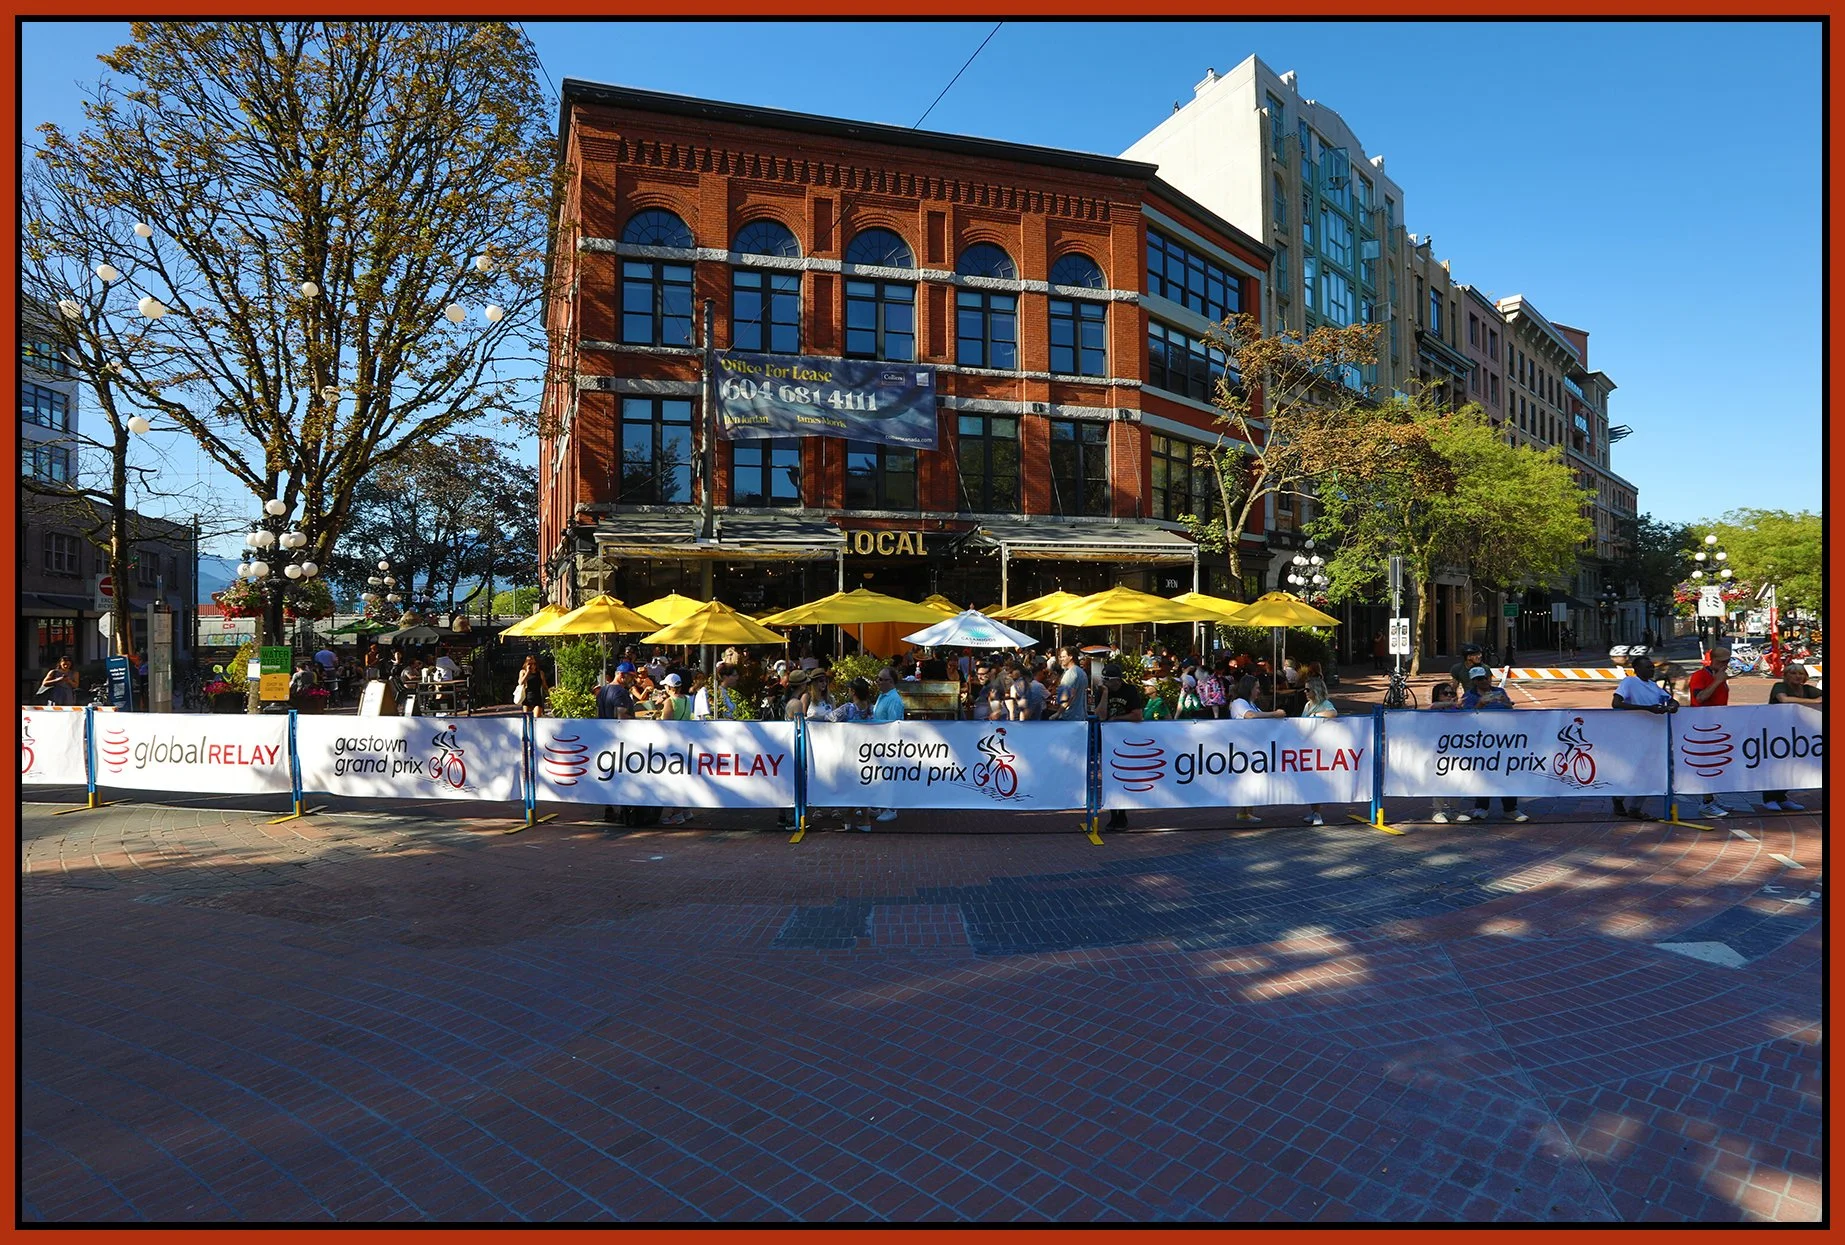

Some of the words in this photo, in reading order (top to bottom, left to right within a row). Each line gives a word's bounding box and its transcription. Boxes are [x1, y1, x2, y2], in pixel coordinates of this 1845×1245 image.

[720, 358, 762, 375] Office
[765, 363, 789, 378] For
[792, 365, 832, 382] Lease
[722, 377, 773, 401] 604
[778, 384, 821, 405] 681
[827, 390, 877, 412] 4111
[796, 415, 821, 424] James
[821, 417, 847, 428] Morris
[841, 530, 928, 555] LOCAL
[261, 658, 289, 666] STREET
[262, 650, 289, 659] WATER
[334, 735, 408, 756] gastown
[858, 739, 949, 763] gastown
[1437, 730, 1528, 754] gastown
[1742, 727, 1822, 769] globa
[334, 755, 388, 777] grand
[391, 757, 424, 778] prix
[860, 761, 922, 785] grand
[927, 762, 967, 786] prix
[1435, 751, 1500, 776] grand
[1505, 752, 1547, 776] prix
